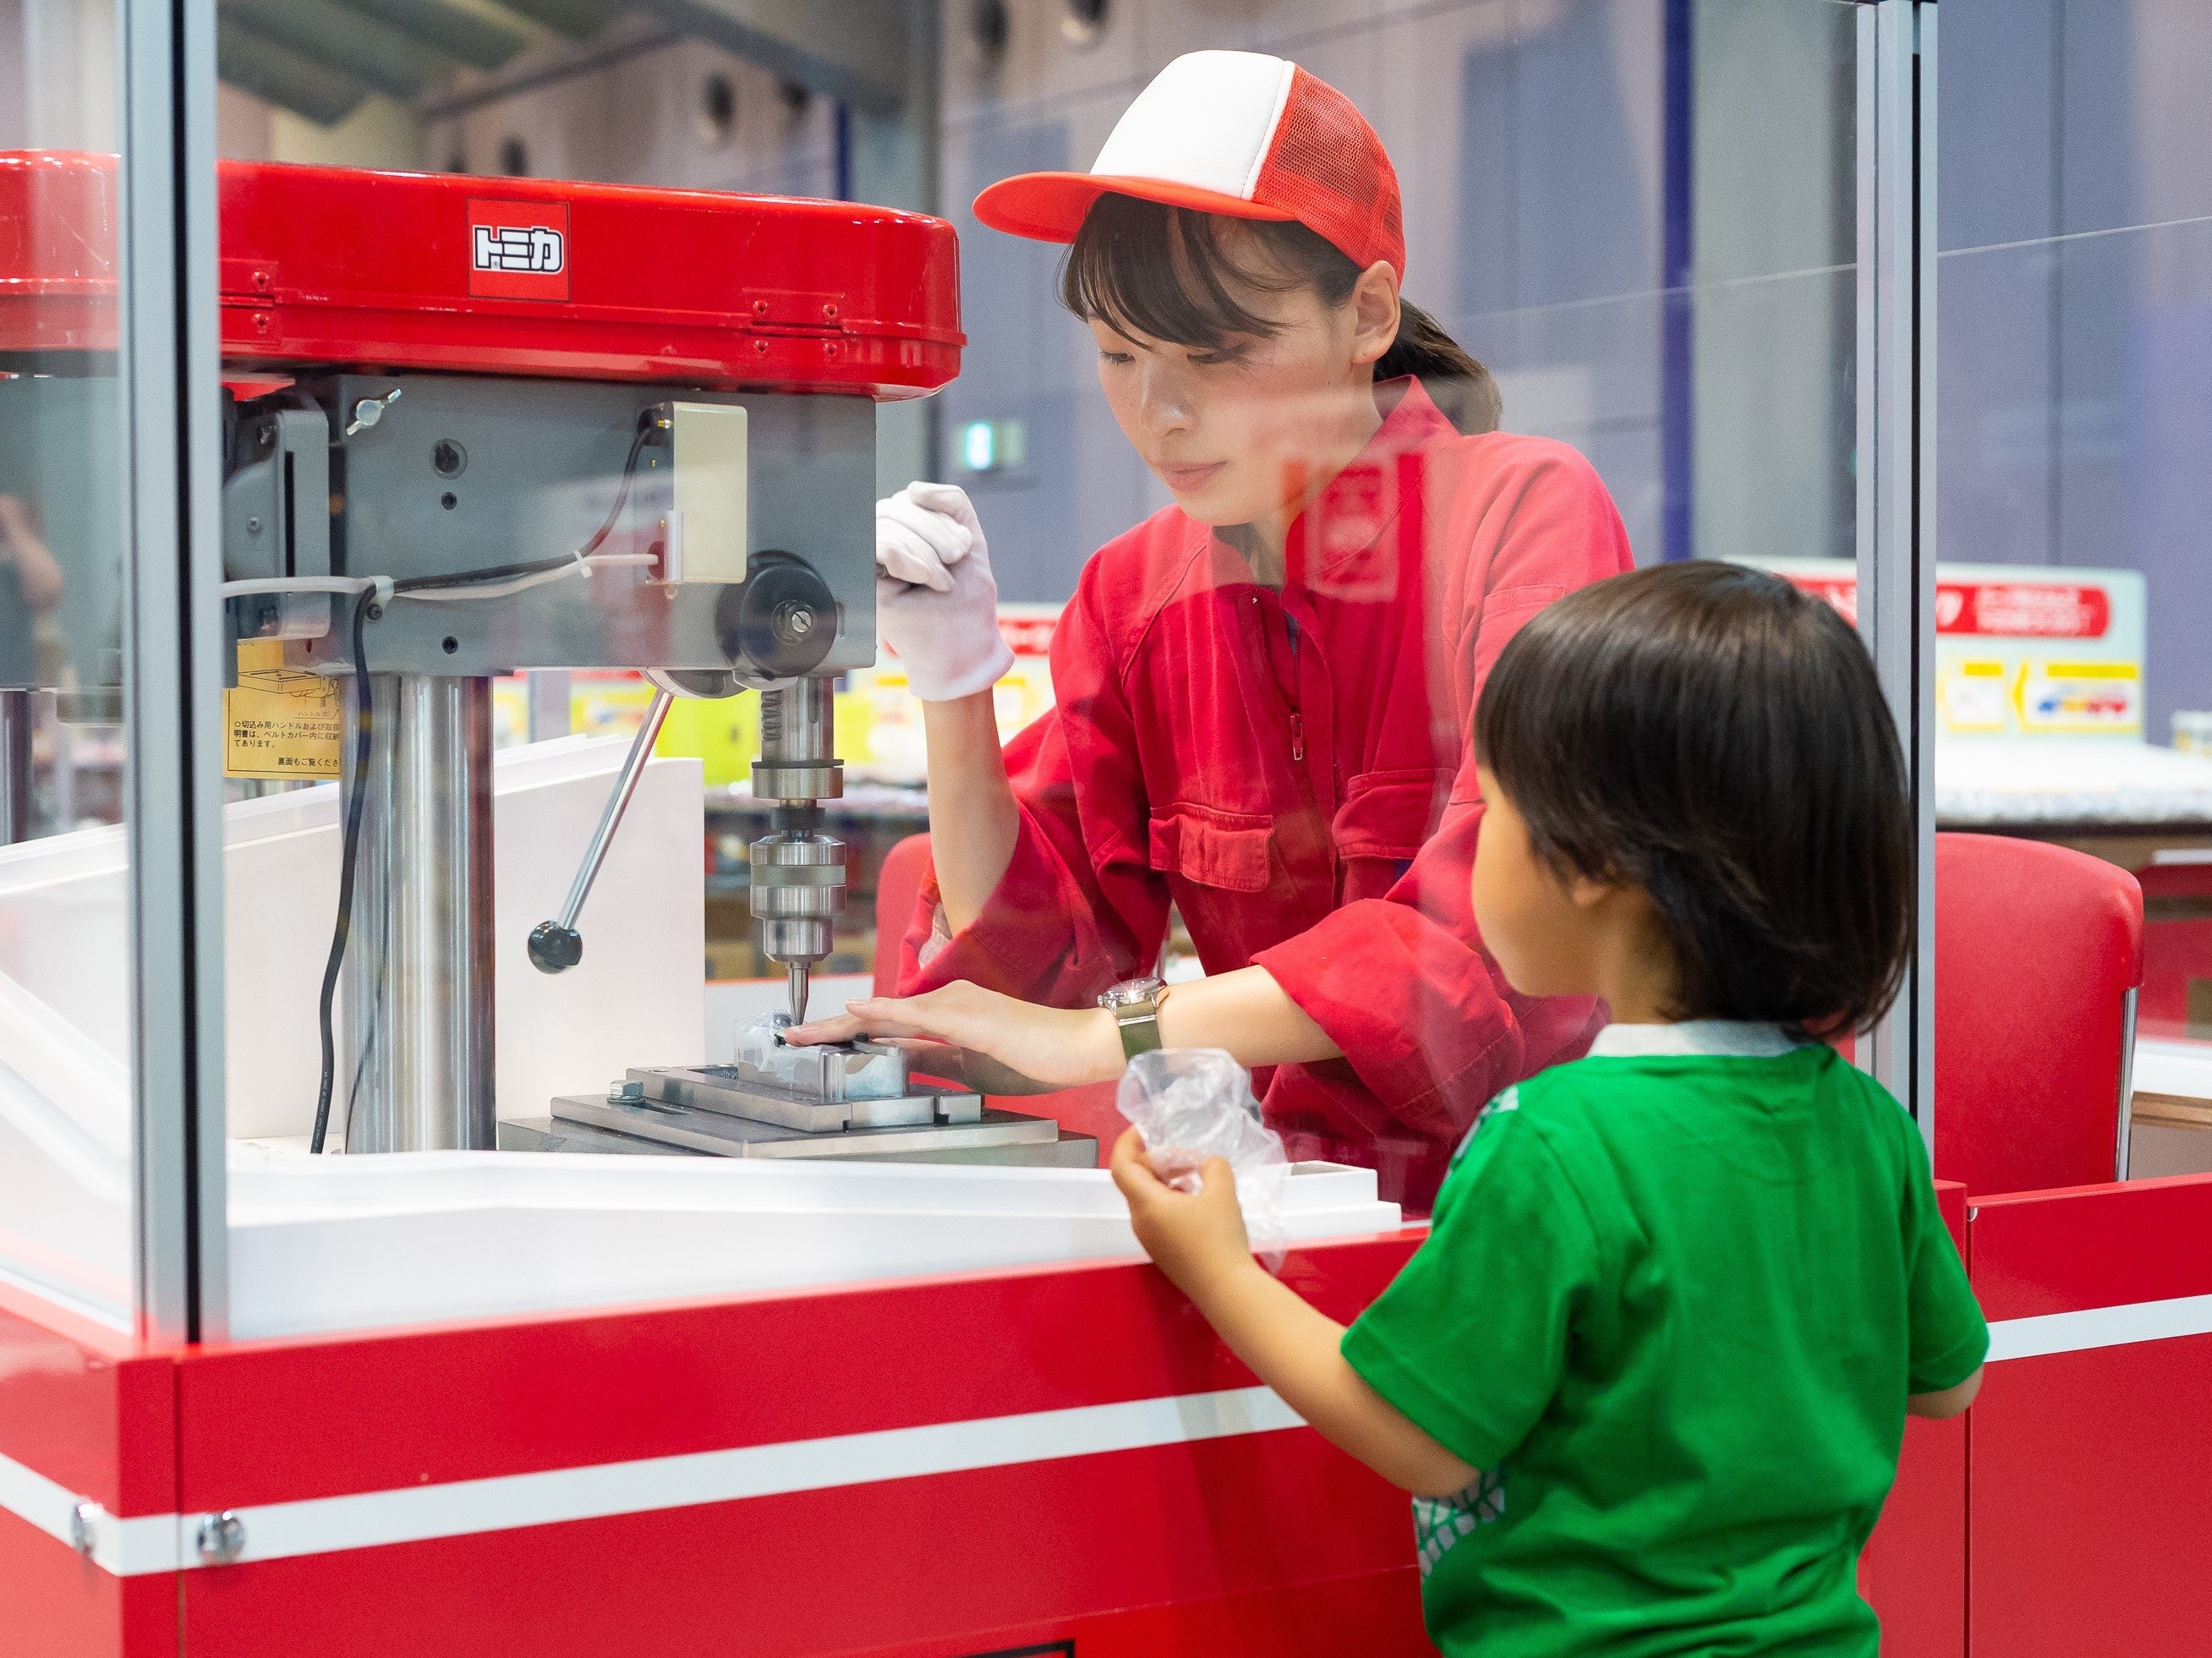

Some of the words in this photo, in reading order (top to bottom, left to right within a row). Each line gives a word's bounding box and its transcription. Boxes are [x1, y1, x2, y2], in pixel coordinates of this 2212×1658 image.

[473, 225, 564, 275] トミカ
[234, 739, 275, 748] てあります。
